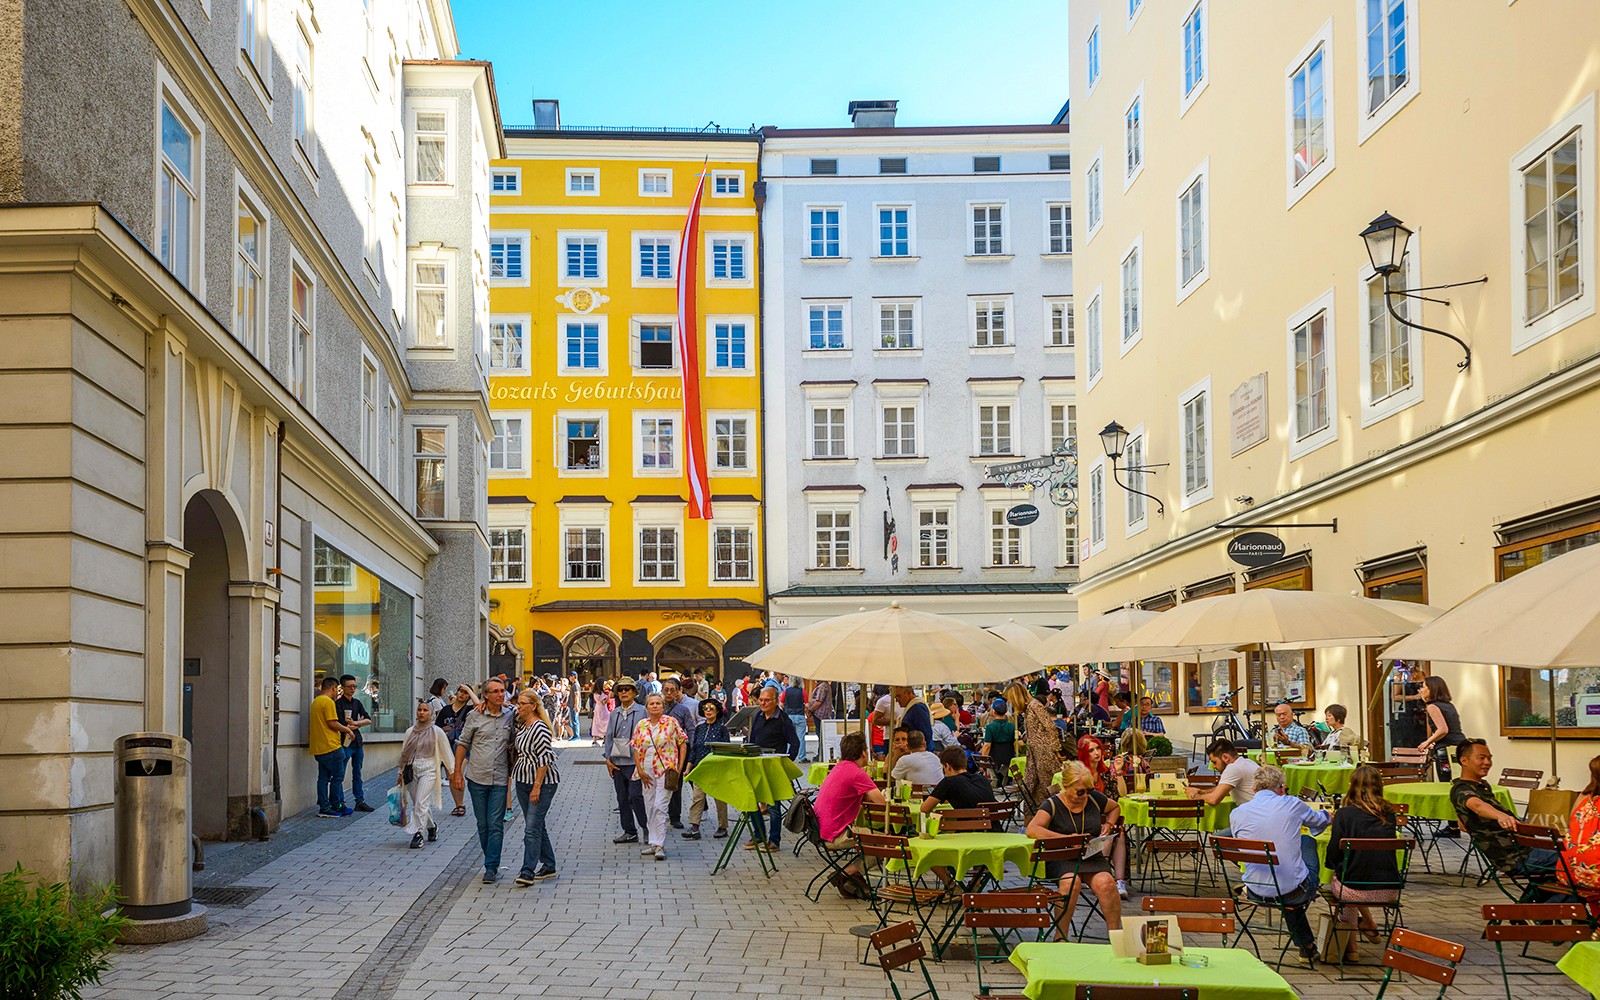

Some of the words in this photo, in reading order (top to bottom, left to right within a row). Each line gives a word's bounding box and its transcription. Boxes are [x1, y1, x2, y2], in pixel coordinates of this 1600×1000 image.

[564, 381, 682, 403] Geburtshau
[1229, 541, 1282, 552] Marionnaud
[661, 611, 702, 621] SPAR
[1529, 813, 1568, 834] ZARA
